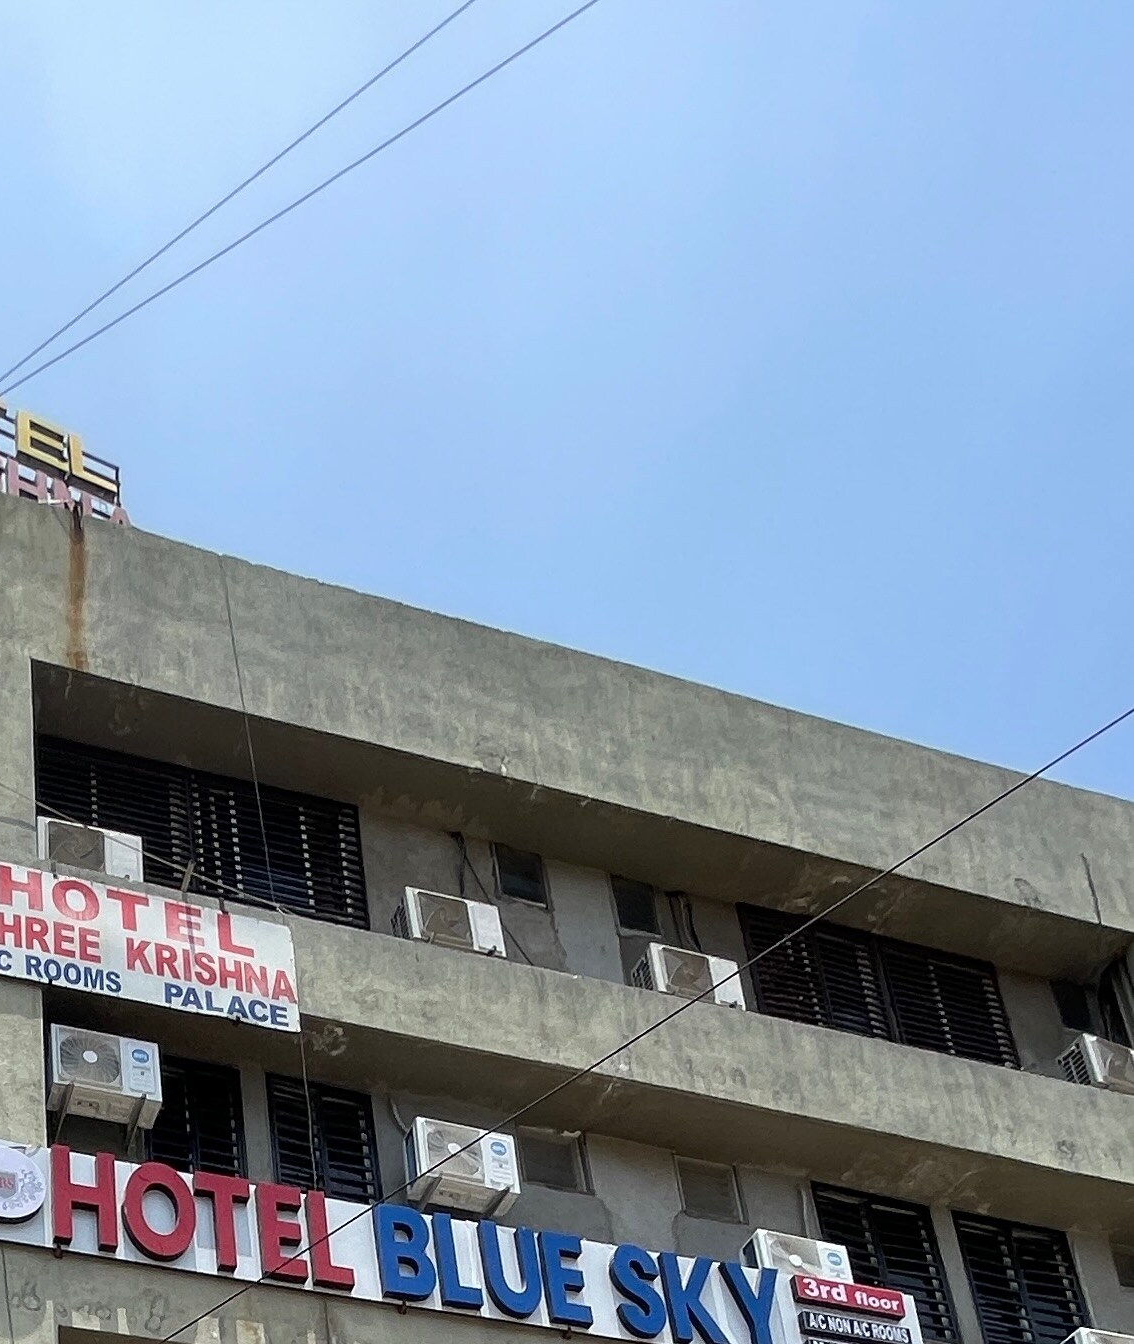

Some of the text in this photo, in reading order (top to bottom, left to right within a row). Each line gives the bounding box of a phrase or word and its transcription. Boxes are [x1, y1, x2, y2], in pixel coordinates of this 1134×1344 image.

[25, 954, 122, 992] ROOMS
[165, 982, 289, 1027] PALACE
[126, 937, 297, 1002] KRISHNA
[51, 1144, 355, 1291] HOTEL
[374, 1204, 593, 1329] BLUE
[802, 1278, 899, 1311] 3rd floor
[828, 1316, 852, 1338] NON
[872, 1323, 909, 1344] ROOMS
